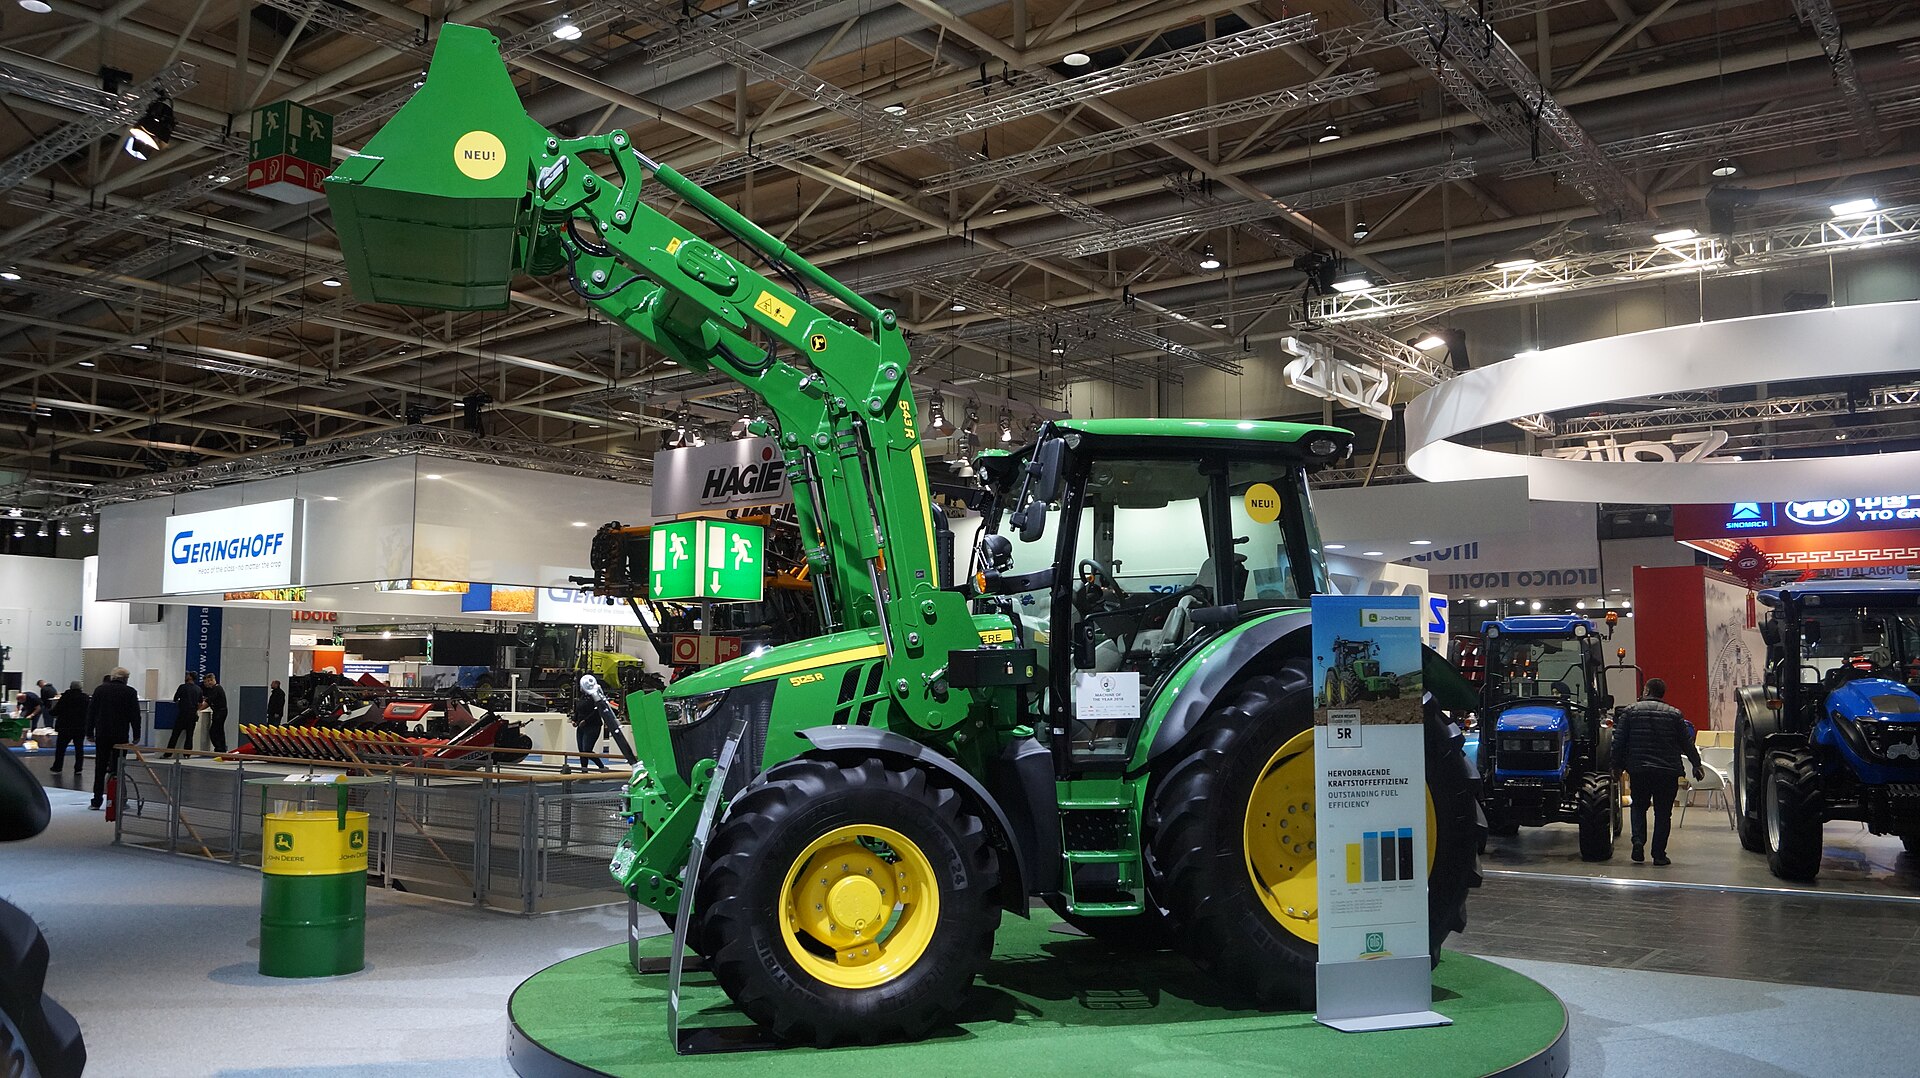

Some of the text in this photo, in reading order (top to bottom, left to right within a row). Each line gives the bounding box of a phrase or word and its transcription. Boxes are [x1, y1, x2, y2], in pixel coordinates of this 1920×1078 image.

[464, 150, 496, 161] NEU!
[898, 400, 916, 439] 543 R
[702, 449, 785, 499] HAGIE
[1251, 499, 1274, 508] NEU!
[1792, 499, 1844, 518] YTO
[1856, 510, 1894, 521] YTO
[1725, 520, 1768, 529] SINOMACH
[171, 530, 284, 565] GERINGHOFF
[789, 672, 825, 687] 5125 R
[1337, 727, 1352, 739] 5R
[1327, 768, 1391, 777] HERVORRAGENDE
[1328, 778, 1409, 788] KRAFTSTOFFEFFIZIENZ
[1328, 789, 1399, 799] OUTSTANDING FUEL
[1328, 800, 1370, 809] EFFICIENCY
[281, 854, 305, 862] DEERE
